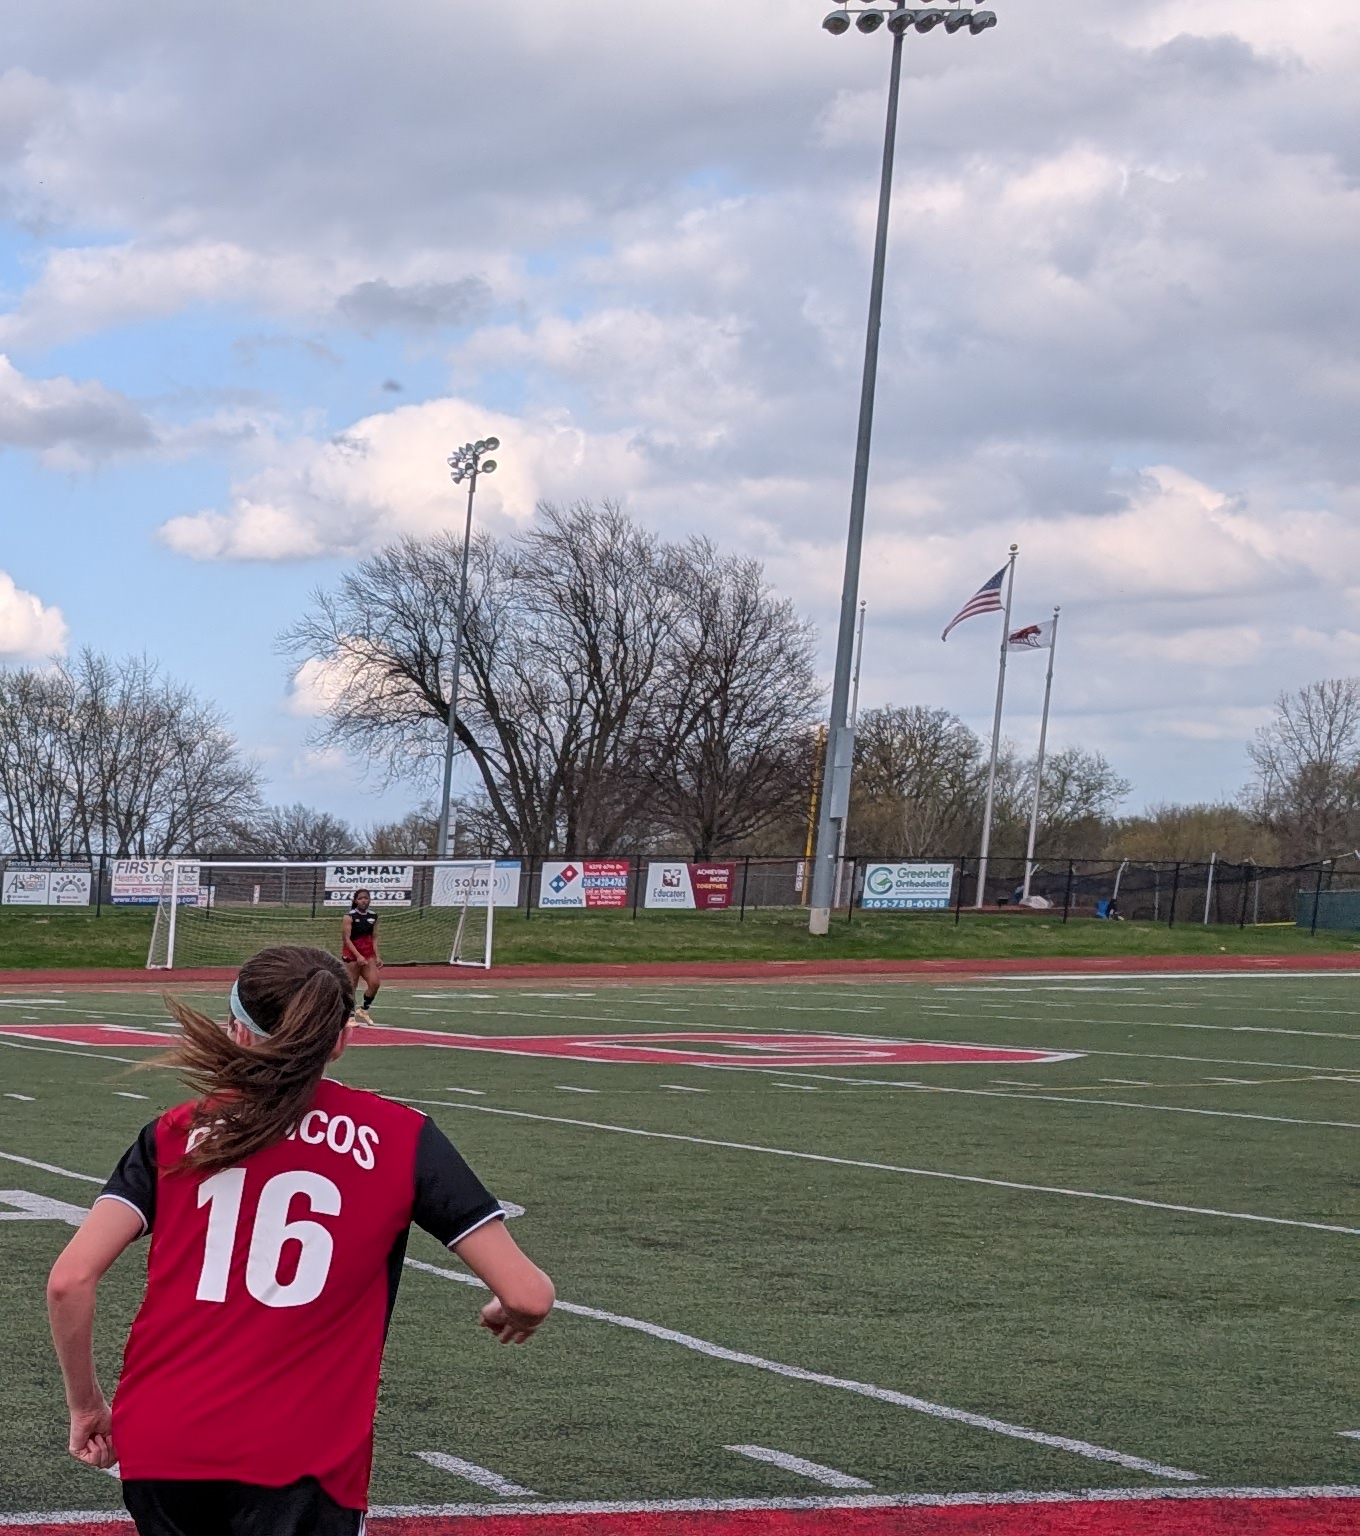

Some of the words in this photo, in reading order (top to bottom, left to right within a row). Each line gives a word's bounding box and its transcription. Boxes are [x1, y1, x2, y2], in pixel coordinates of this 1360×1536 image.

[115, 861, 159, 874] FIRST
[333, 865, 407, 875] ASPHALT
[897, 867, 951, 878] Greenleaf
[115, 875, 143, 884] Heating
[338, 876, 401, 884] Contractors
[653, 888, 686, 898] Educators
[542, 897, 583, 905] Domino's
[196, 1168, 341, 1307] 16
